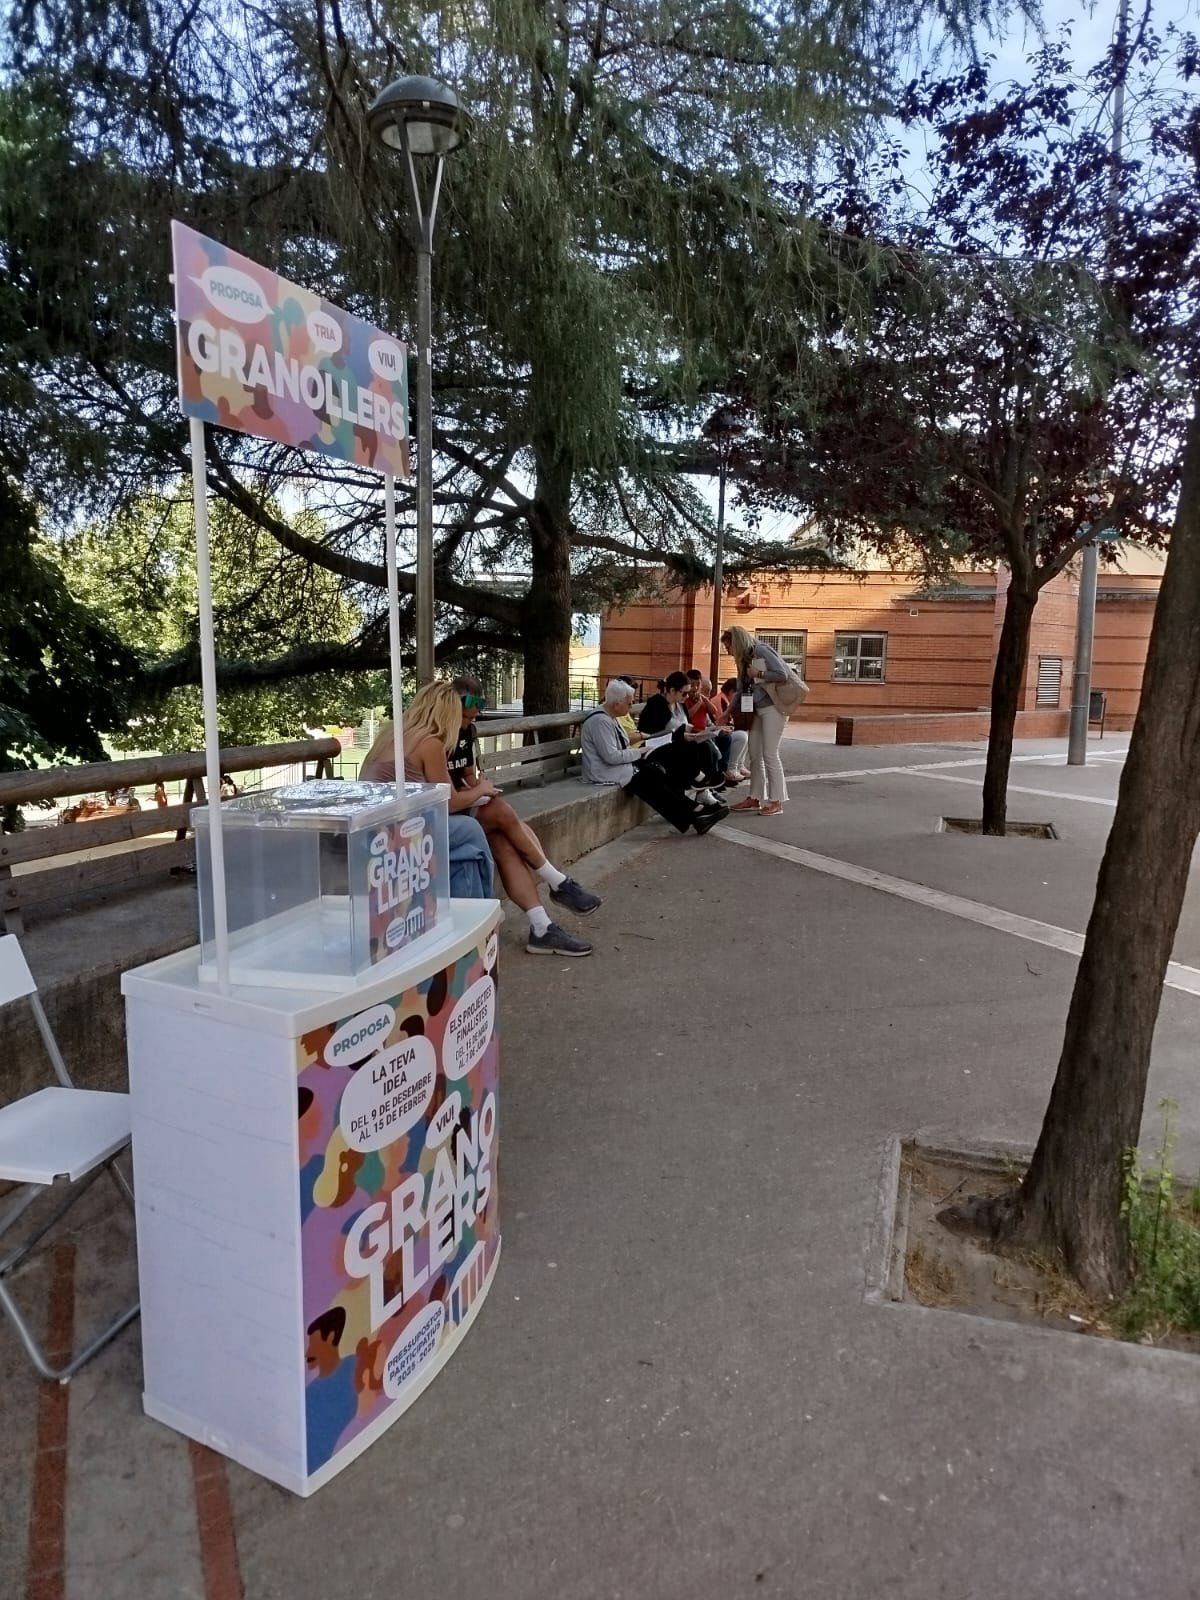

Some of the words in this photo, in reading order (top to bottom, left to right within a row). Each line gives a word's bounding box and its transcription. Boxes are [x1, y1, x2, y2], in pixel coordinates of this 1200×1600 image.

[209, 279, 263, 308] PROPOSA
[314, 323, 336, 341] TRIA
[187, 319, 406, 441] GRANOLLERS
[369, 834, 434, 888] GRANO
[376, 866, 430, 915] LLERS
[449, 1014, 462, 1034] ELS
[462, 985, 492, 1024] PROJECTES
[456, 1005, 488, 1044] FINALISTES
[333, 1014, 391, 1057] PROPOSA
[372, 1065, 387, 1084] LA
[389, 1048, 416, 1074] TEVA
[383, 1071, 407, 1096] IDEA
[351, 1114, 369, 1133] DEL
[371, 1109, 377, 1120] 9
[379, 1101, 391, 1116] DE
[392, 1072, 432, 1108] DESEMBRE
[359, 1127, 371, 1143] AL
[374, 1118, 384, 1133] 15
[386, 1110, 397, 1125] DE
[398, 1089, 427, 1118] FEBRER
[343, 1092, 495, 1279] GRANO
[368, 1154, 491, 1333] LLERS
[387, 1306, 442, 1372] PRESSUPOSTOS
[389, 1320, 441, 1382] PARTICIPATIUS
